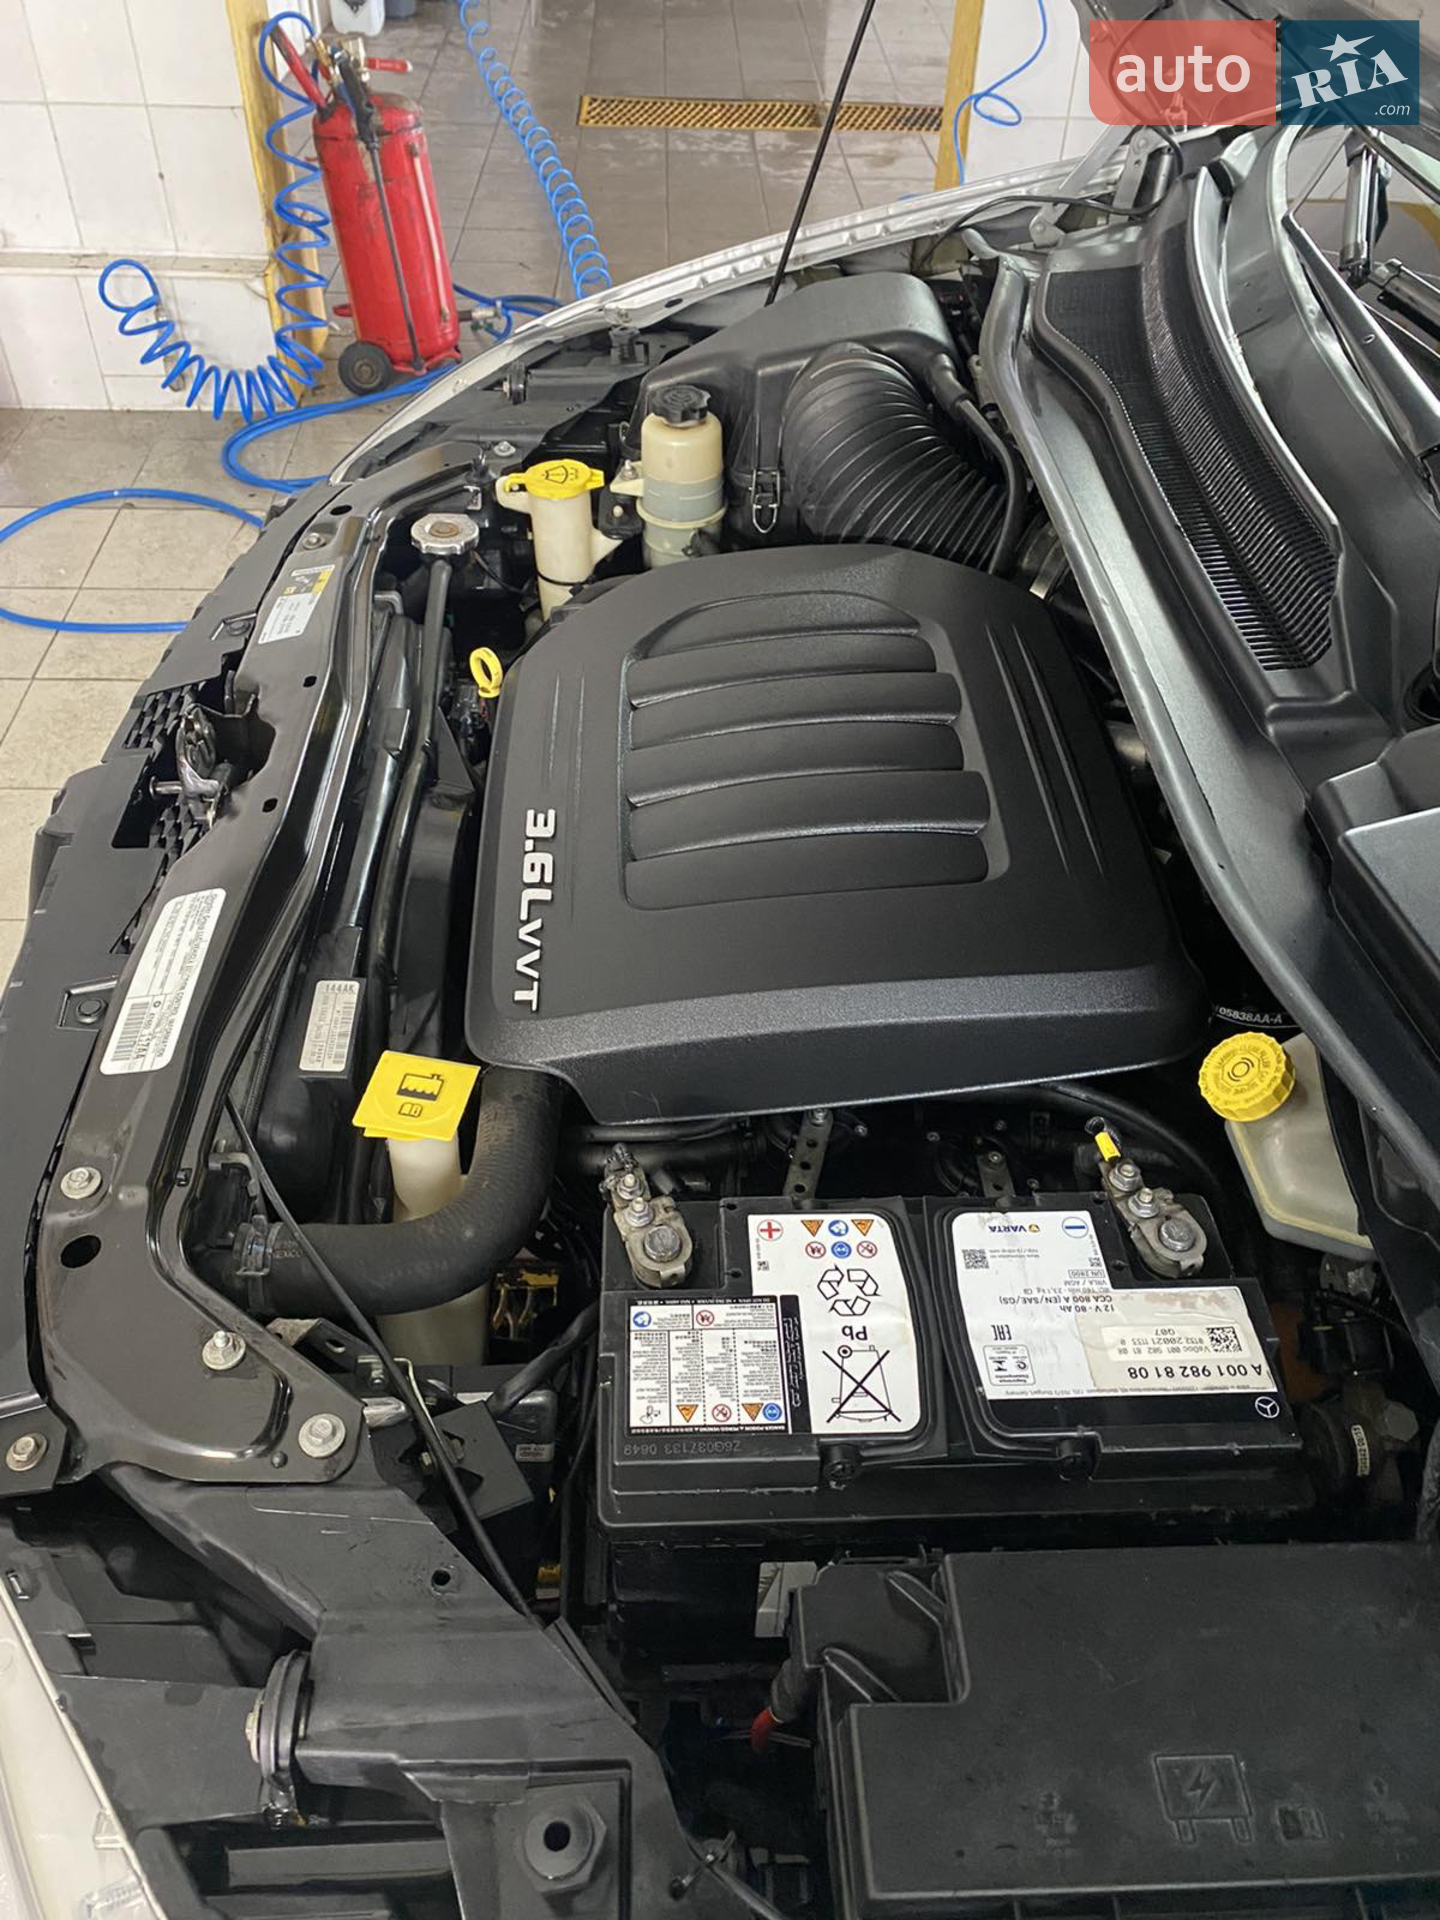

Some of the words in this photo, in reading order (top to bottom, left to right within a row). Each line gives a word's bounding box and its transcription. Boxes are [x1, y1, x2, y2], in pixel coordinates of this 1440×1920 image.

[989, 1224, 1027, 1233] VARTA
[841, 1325, 868, 1341] Pb
[1127, 1366, 1150, 1380] 08
[1155, 1365, 1176, 1379] 81
[1180, 1364, 1213, 1379] 982
[1218, 1363, 1248, 1378] 001
[1251, 1363, 1263, 1377] A
